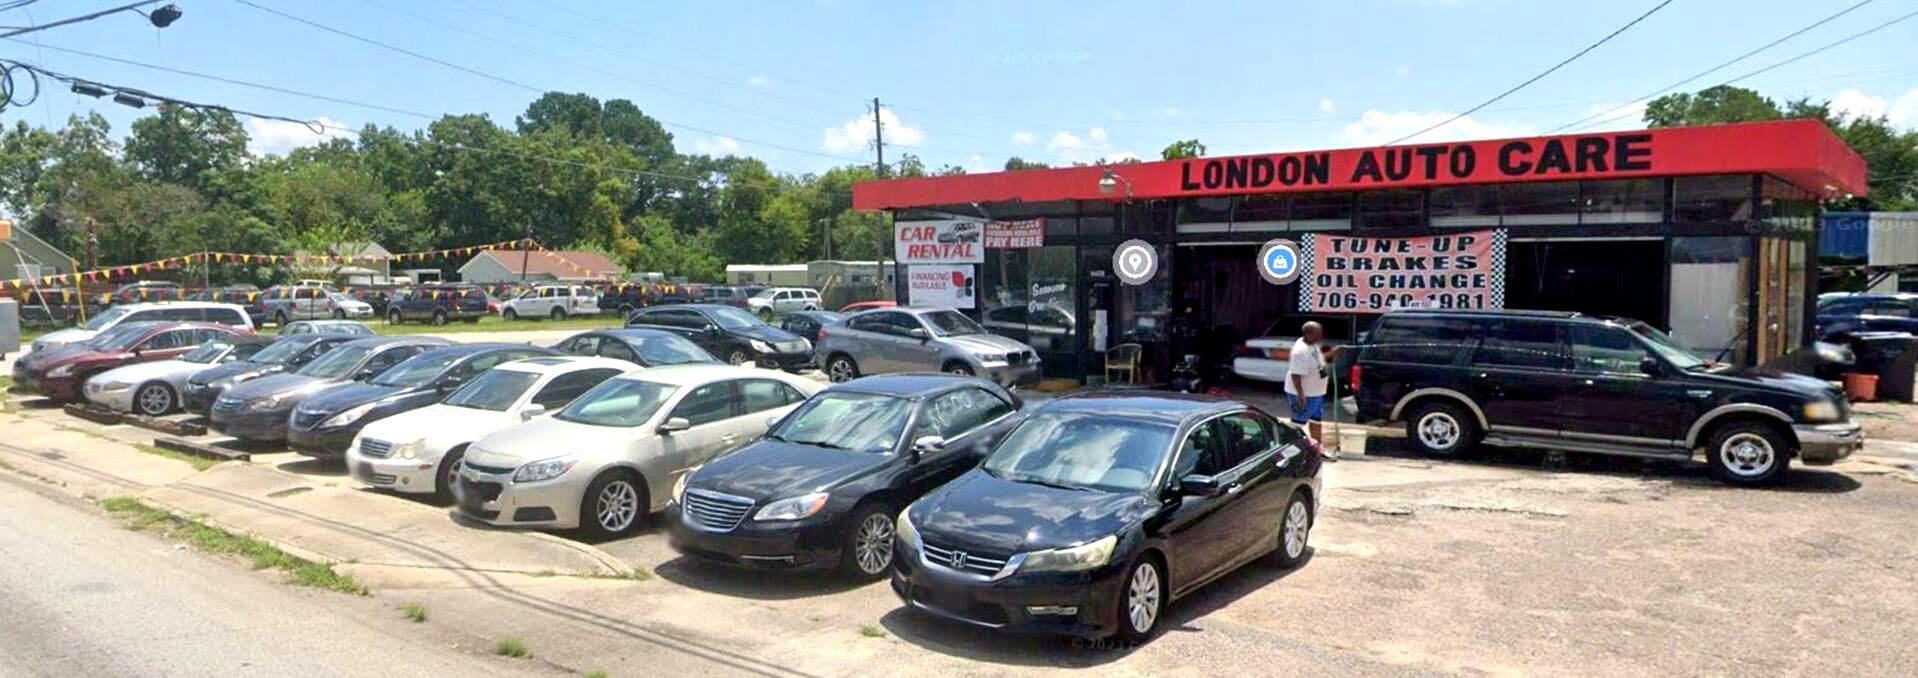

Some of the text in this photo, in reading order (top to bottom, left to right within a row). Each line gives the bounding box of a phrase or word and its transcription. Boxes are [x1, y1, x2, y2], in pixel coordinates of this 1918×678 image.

[1181, 134, 1653, 191] LONDON AUTO CARE
[901, 226, 937, 241] CAR
[986, 235, 1043, 248] PAY HERE
[908, 243, 976, 259] RENTAL
[1331, 235, 1476, 253] TUNE-UP
[1326, 255, 1478, 271] BRAKES
[1316, 273, 1487, 289] OIL CHANGE
[1316, 292, 1485, 309] 706-940981
